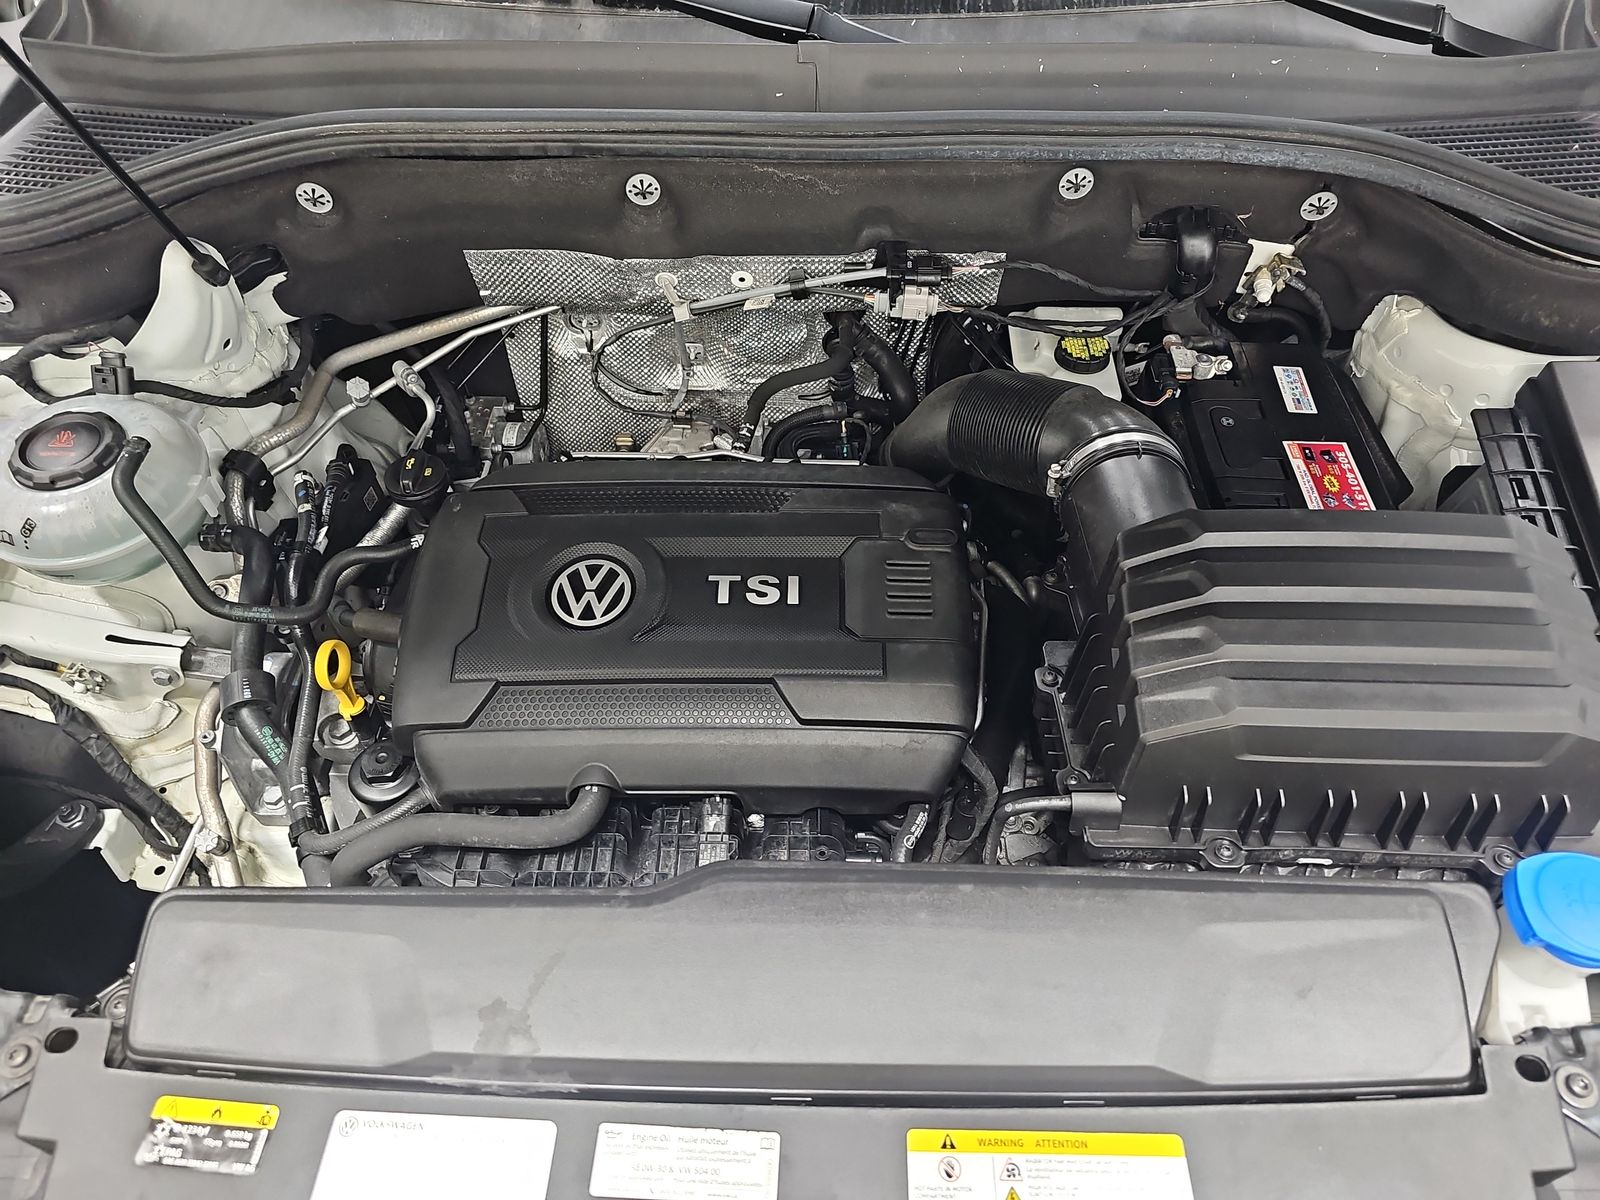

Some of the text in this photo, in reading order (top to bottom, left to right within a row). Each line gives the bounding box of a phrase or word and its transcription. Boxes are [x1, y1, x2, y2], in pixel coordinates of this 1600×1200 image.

[708, 575, 800, 606] TSI
[977, 1138, 1088, 1149] WARNING ATTENTION
